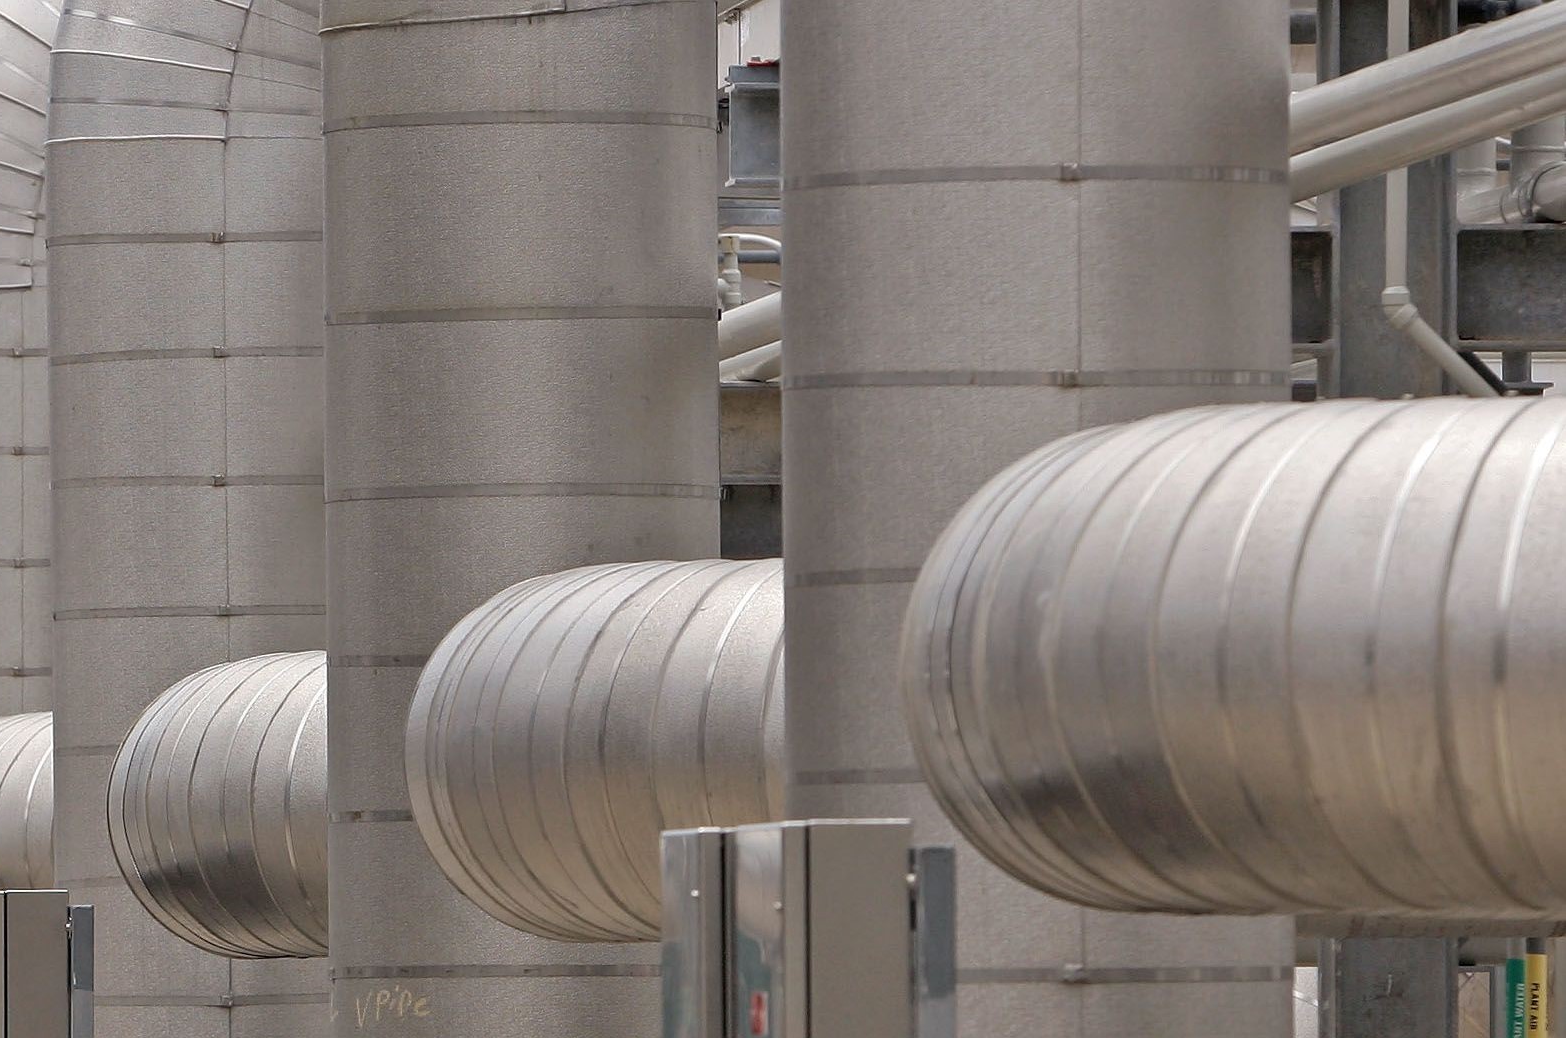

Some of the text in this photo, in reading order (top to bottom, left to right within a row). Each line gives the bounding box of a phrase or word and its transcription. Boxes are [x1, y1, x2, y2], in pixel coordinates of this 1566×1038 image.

[1514, 983, 1525, 1019] WATER
[1529, 982, 1540, 1030] PLANT AIR
